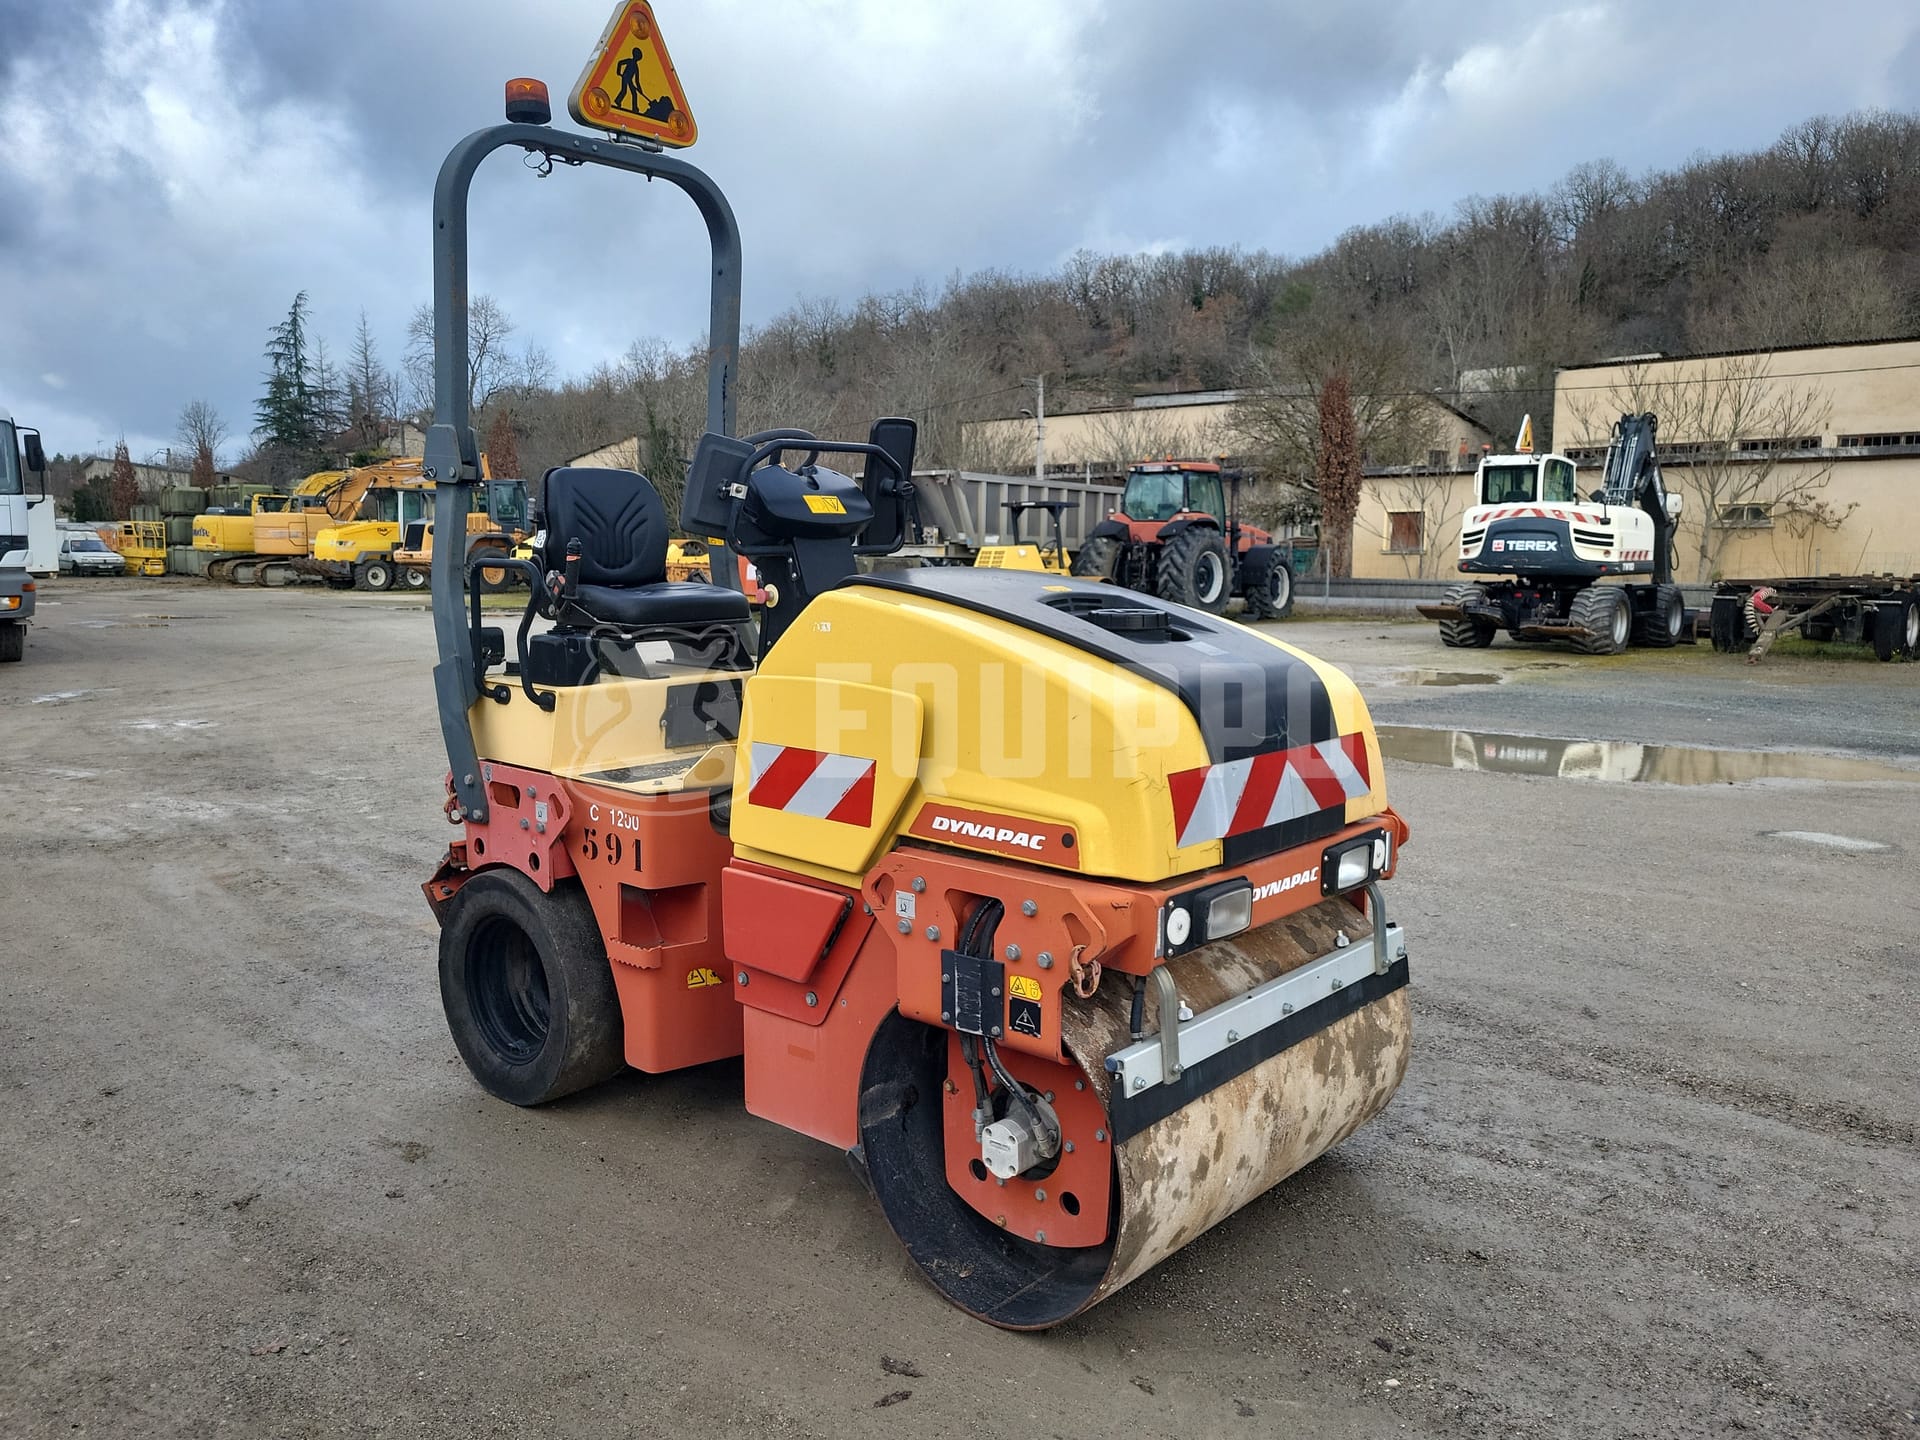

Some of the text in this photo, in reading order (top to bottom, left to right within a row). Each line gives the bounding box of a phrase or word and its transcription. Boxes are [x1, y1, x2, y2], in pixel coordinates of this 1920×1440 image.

[1506, 540, 1558, 552] TEREX
[582, 827, 643, 872] 591
[932, 816, 1046, 850] DYNAPAC
